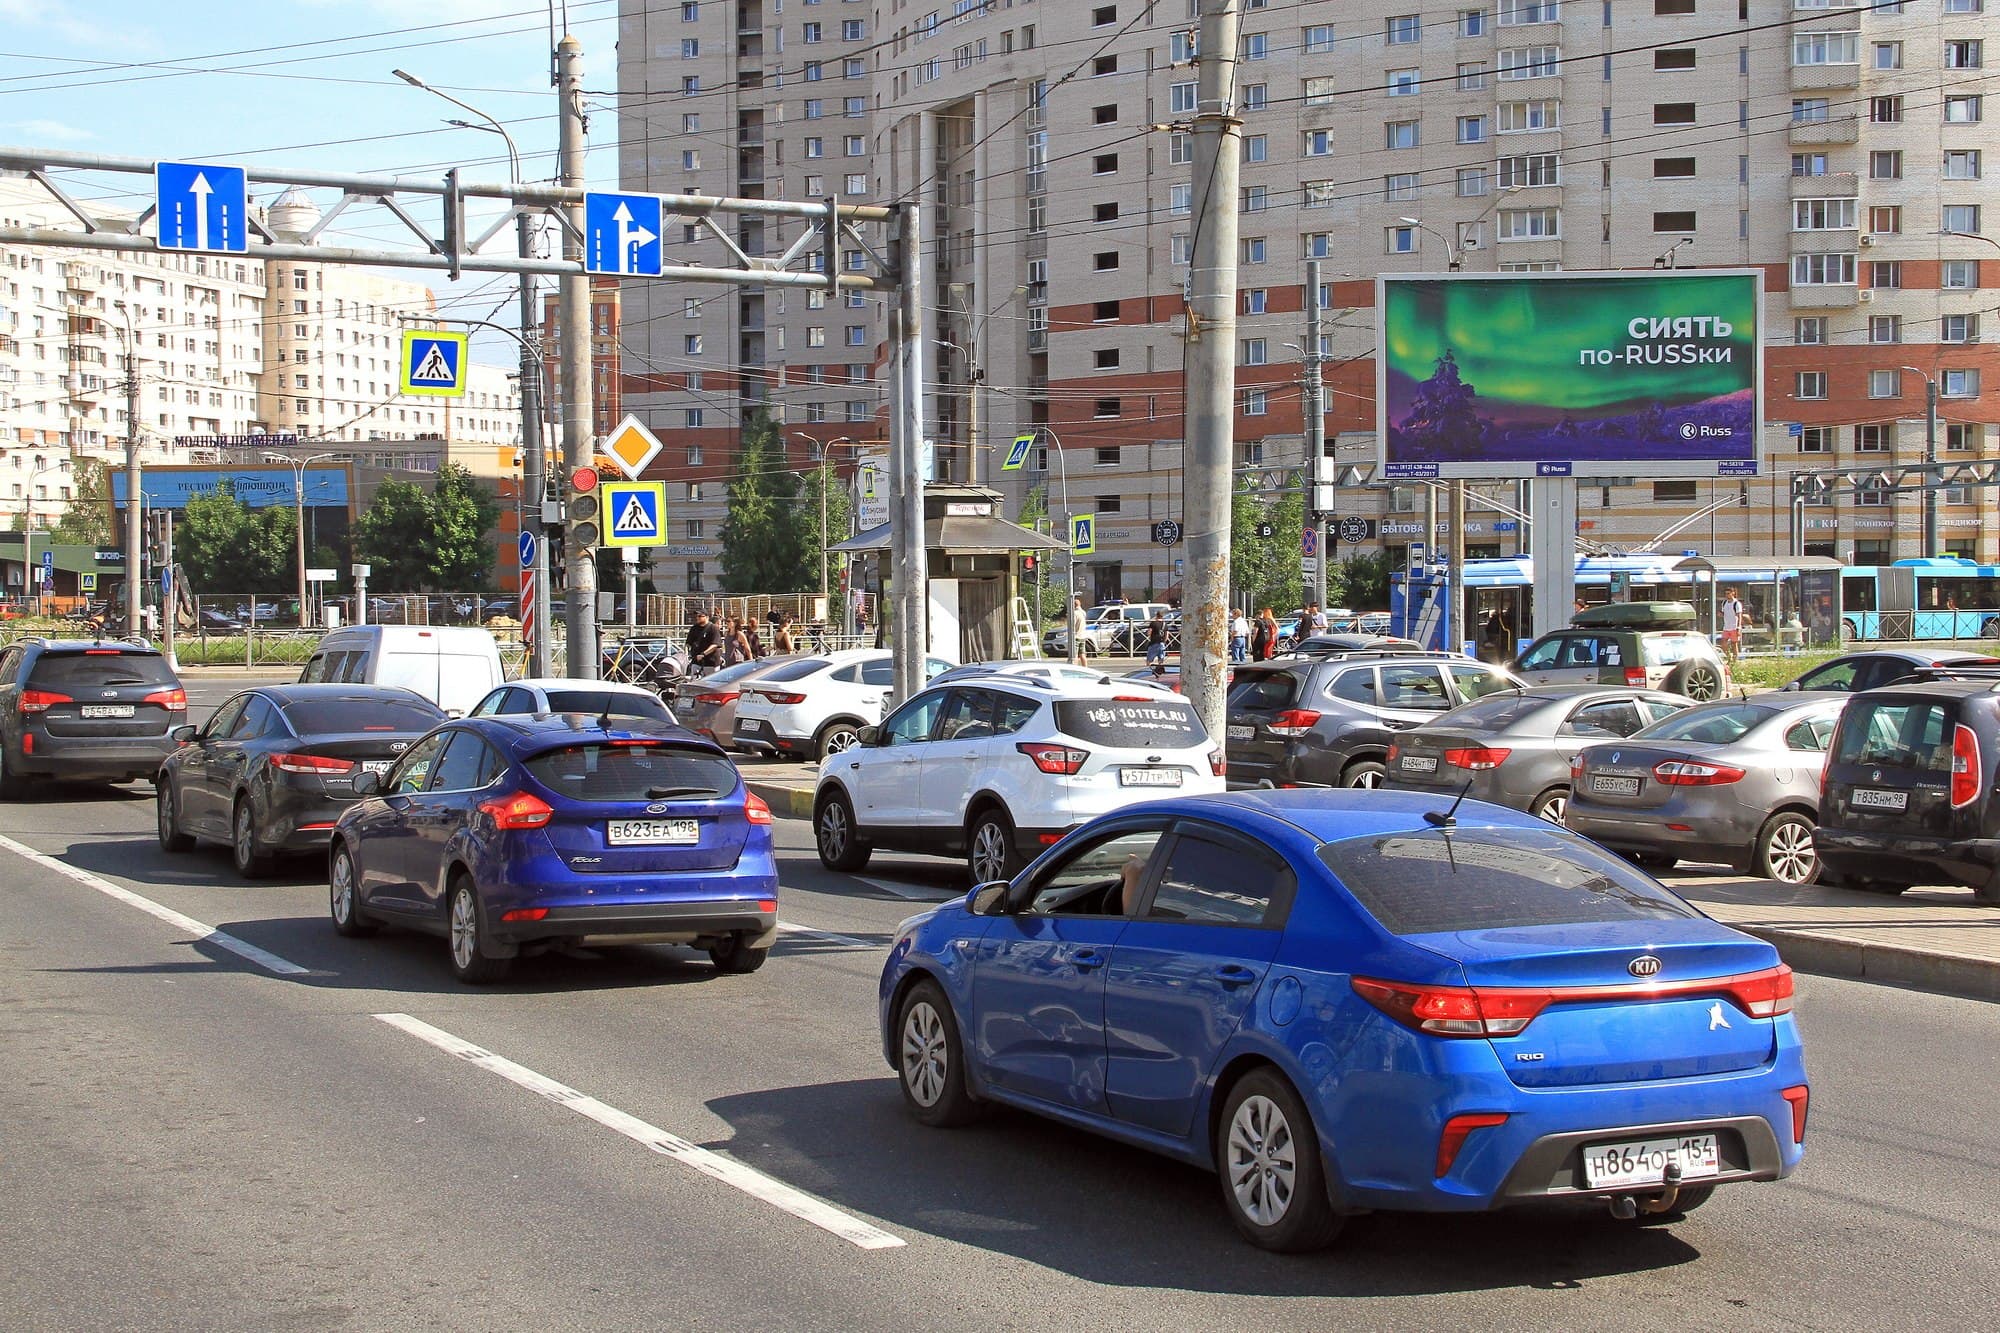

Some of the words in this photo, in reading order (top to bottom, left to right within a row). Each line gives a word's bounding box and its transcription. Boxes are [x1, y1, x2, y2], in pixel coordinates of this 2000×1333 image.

[1628, 316, 1733, 339] СИЯТЬ
[1700, 425, 1732, 437] Russ
[175, 433, 228, 448] МОДНЫЙ
[1382, 524, 1424, 533] БЫТОВА
[1596, 778, 1624, 790] Е655ХС
[1857, 791, 1892, 805] Т835НМ
[1893, 793, 1904, 803] 98
[613, 822, 671, 838] В623ЕА
[673, 821, 694, 833] 198
[1516, 1053, 1545, 1061] RIO
[1681, 1138, 1713, 1160] 154
[1689, 1159, 1705, 1167] RUS
